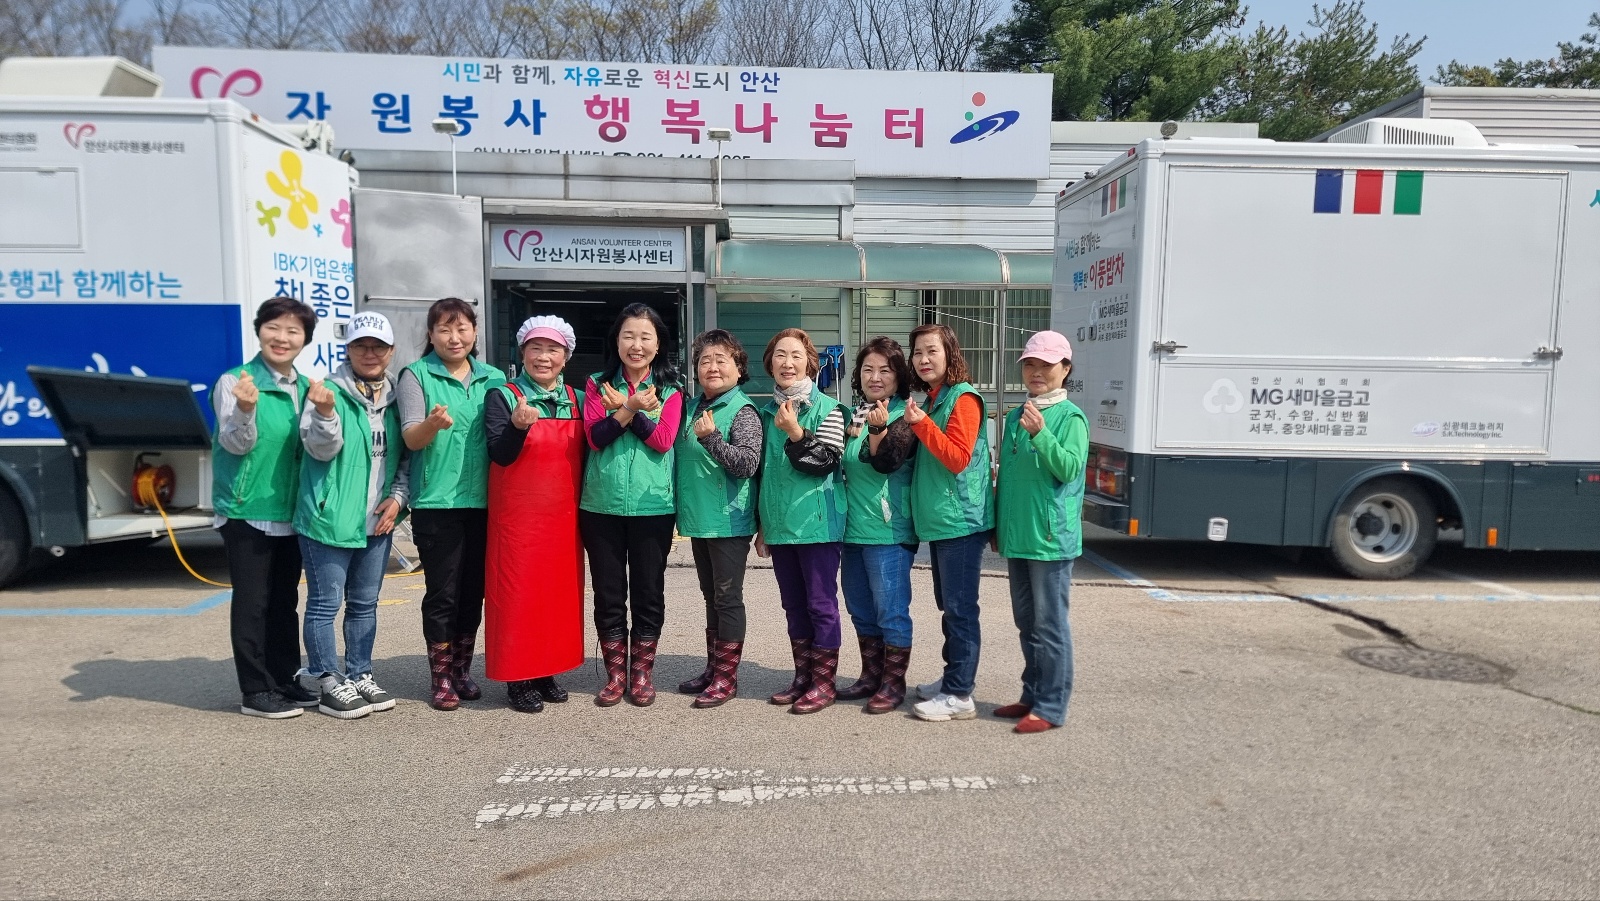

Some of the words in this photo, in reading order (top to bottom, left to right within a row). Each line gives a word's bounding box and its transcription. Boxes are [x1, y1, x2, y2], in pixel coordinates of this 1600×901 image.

[442, 62, 502, 84] 시민과
[511, 64, 556, 86] 함께,
[564, 66, 643, 89] 자유로운
[653, 69, 729, 92] 혁신도시
[739, 71, 781, 94] 안산
[532, 247, 673, 265] 안산시자원봉사센터
[571, 238, 597, 246] ANSAN
[599, 238, 642, 247] VOLUNTEER
[643, 239, 673, 248] CENTER
[72, 270, 183, 299] 함께하는
[1089, 252, 1125, 290] 이동밥차
[310, 282, 353, 319] 좋은
[1250, 388, 1371, 407] MG새마을금고
